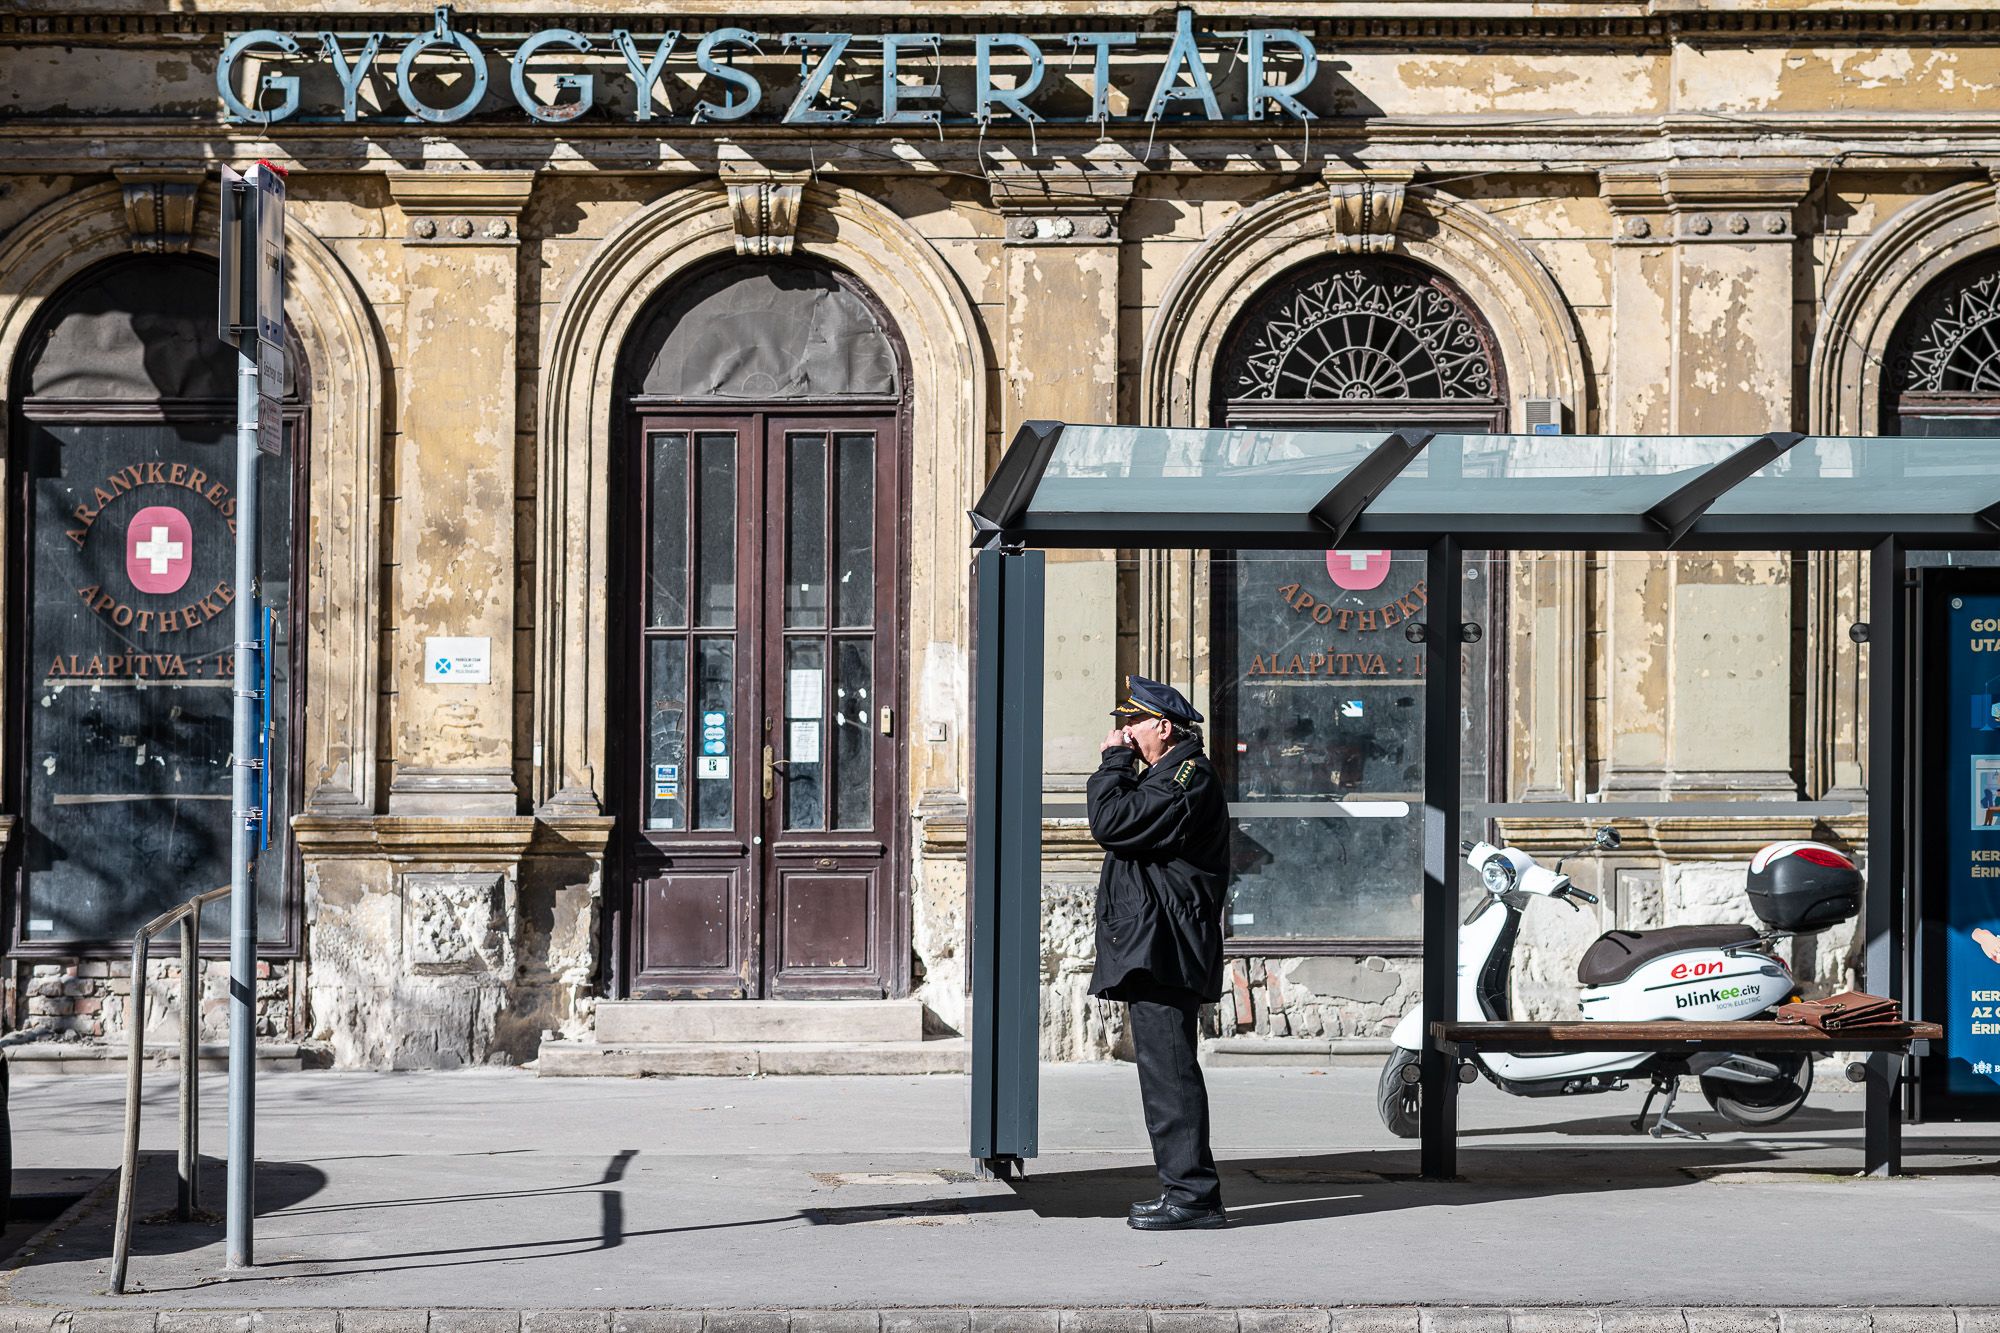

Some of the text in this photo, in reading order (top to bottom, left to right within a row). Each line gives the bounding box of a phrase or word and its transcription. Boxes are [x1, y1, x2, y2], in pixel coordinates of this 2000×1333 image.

[217, 7, 1318, 124] GYÓGYSZERTÁR
[66, 462, 236, 548] ARANYKERES
[78, 580, 236, 633] APOTHEKE
[1970, 618, 2000, 632] GO
[48, 647, 188, 676] ALAPÍTVA
[1248, 646, 1389, 675] ALAPÍTVA
[1676, 985, 1760, 1009] blinkee.city
[1716, 996, 1761, 1010] 100% ELECTRIC
[1971, 1006, 1992, 1018] AZ
